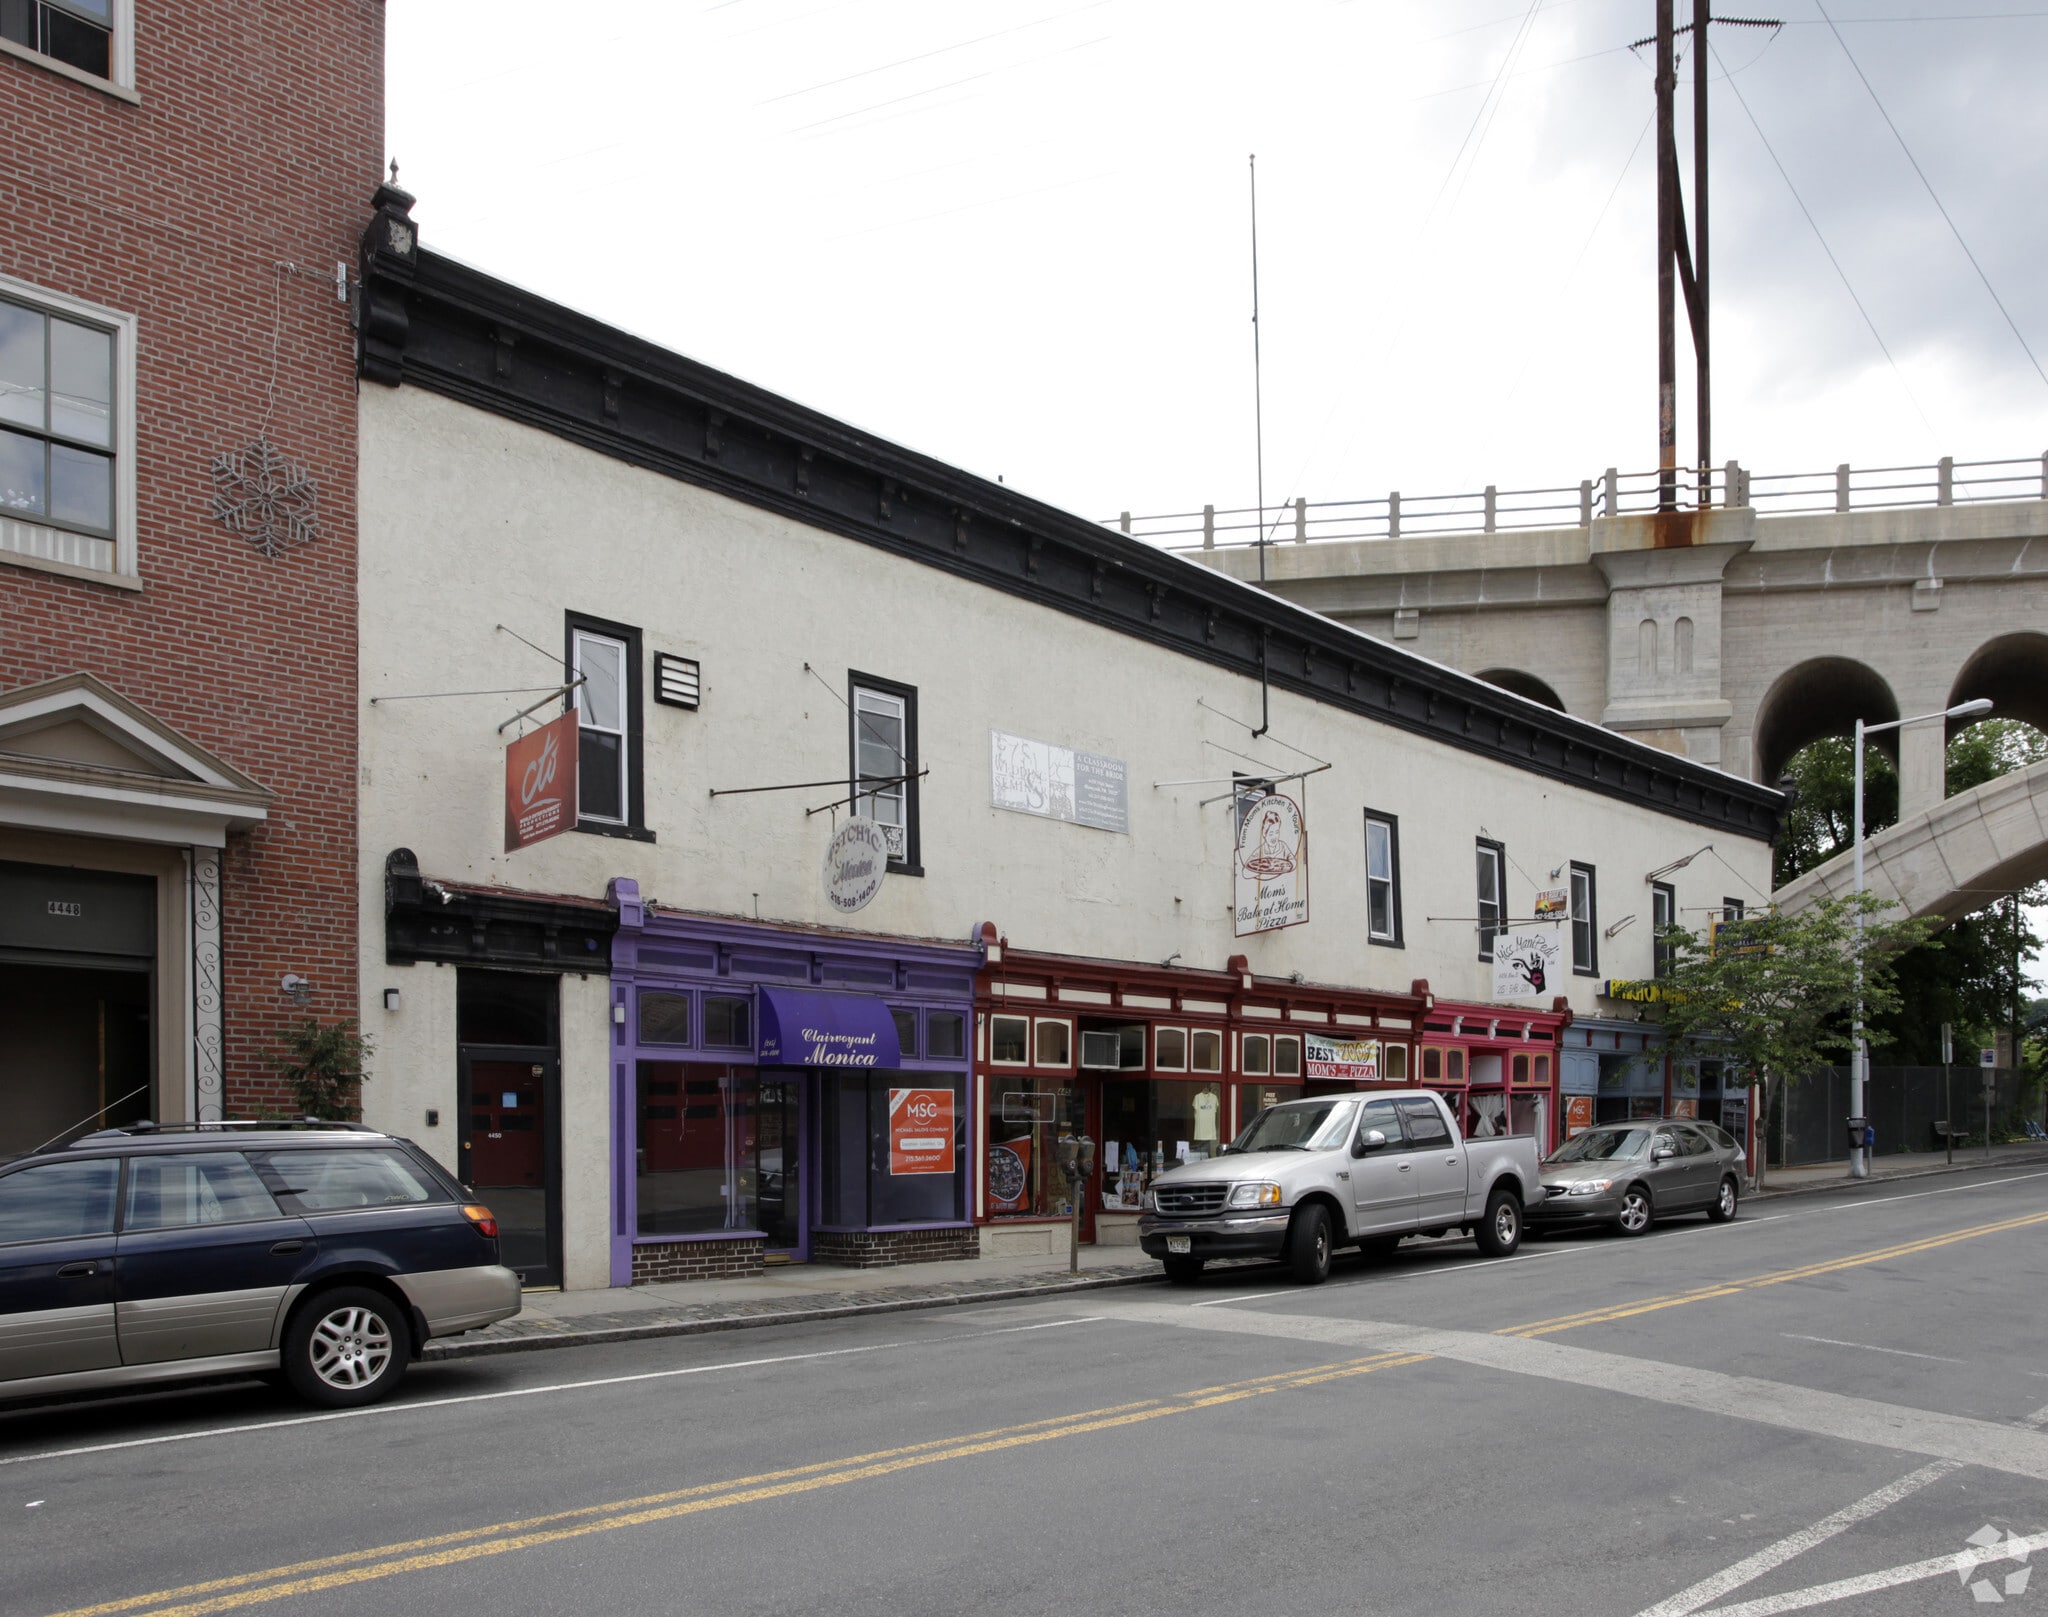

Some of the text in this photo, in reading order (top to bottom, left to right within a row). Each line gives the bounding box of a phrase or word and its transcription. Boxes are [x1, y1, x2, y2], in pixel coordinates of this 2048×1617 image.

[1076, 763, 1124, 781] FOR THE BRIDE
[1084, 757, 1124, 772] CLASSROOM
[1240, 828, 1248, 849] From
[1261, 797, 1286, 808] Kitchen
[828, 824, 880, 866] PSYCHIC
[1254, 884, 1286, 901] Mom's
[49, 902, 80, 916] 4448
[1236, 897, 1305, 923] Bake at Home
[1255, 915, 1287, 930] Pizza
[801, 1028, 877, 1049] Clairvoyant
[804, 1043, 879, 1066] Monica
[1307, 1046, 1335, 1062] BEST
[1306, 1063, 1337, 1077] MOM'S
[1349, 1065, 1375, 1078] PIZZA
[907, 1103, 938, 1118] MSC
[1573, 1105, 1585, 1115] MSC
